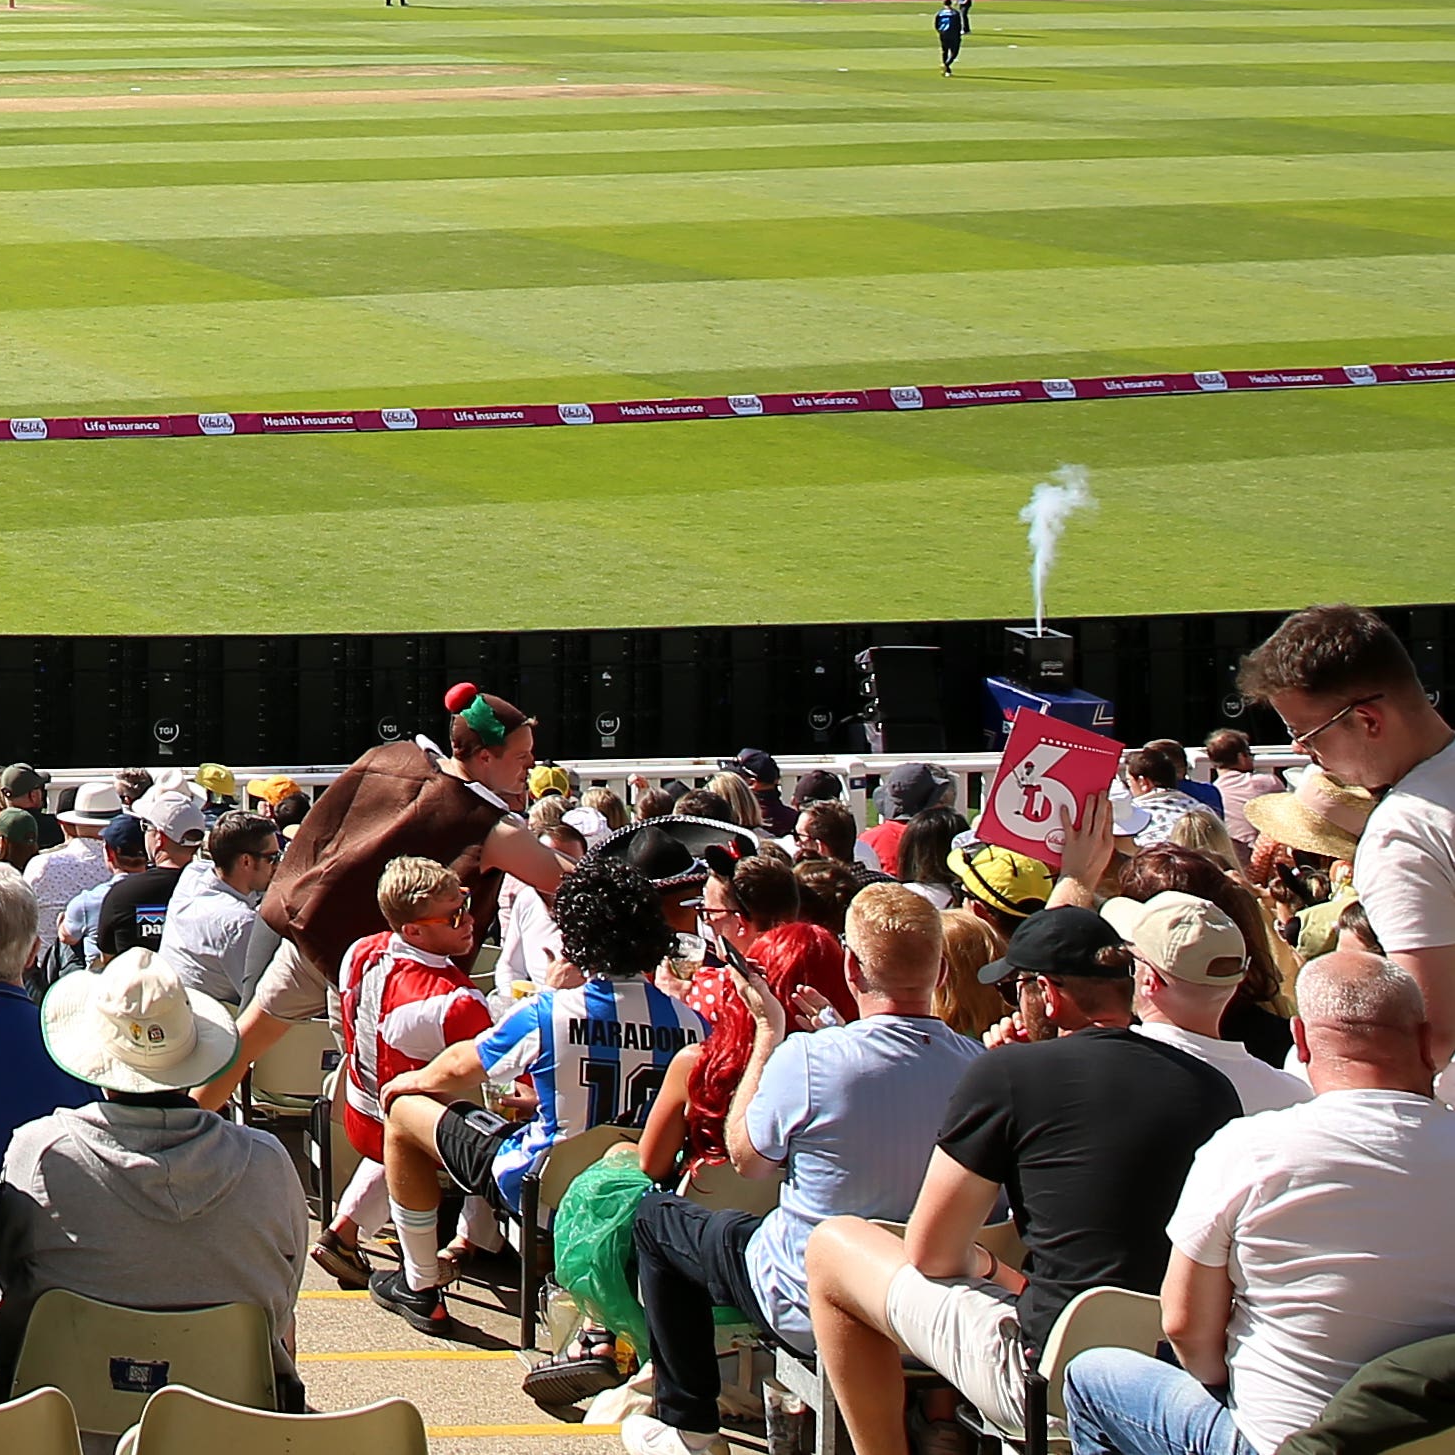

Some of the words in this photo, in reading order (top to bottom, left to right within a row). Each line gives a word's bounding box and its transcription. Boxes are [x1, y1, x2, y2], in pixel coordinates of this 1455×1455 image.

[263, 415, 299, 428] Health
[302, 414, 353, 427] insurance
[453, 411, 473, 422] Life
[475, 409, 524, 421] insurance
[84, 420, 106, 432] Life
[108, 419, 160, 431] insurance
[158, 726, 174, 735] TGI
[994, 743, 1078, 843] 6
[569, 1017, 699, 1053] MARADONA
